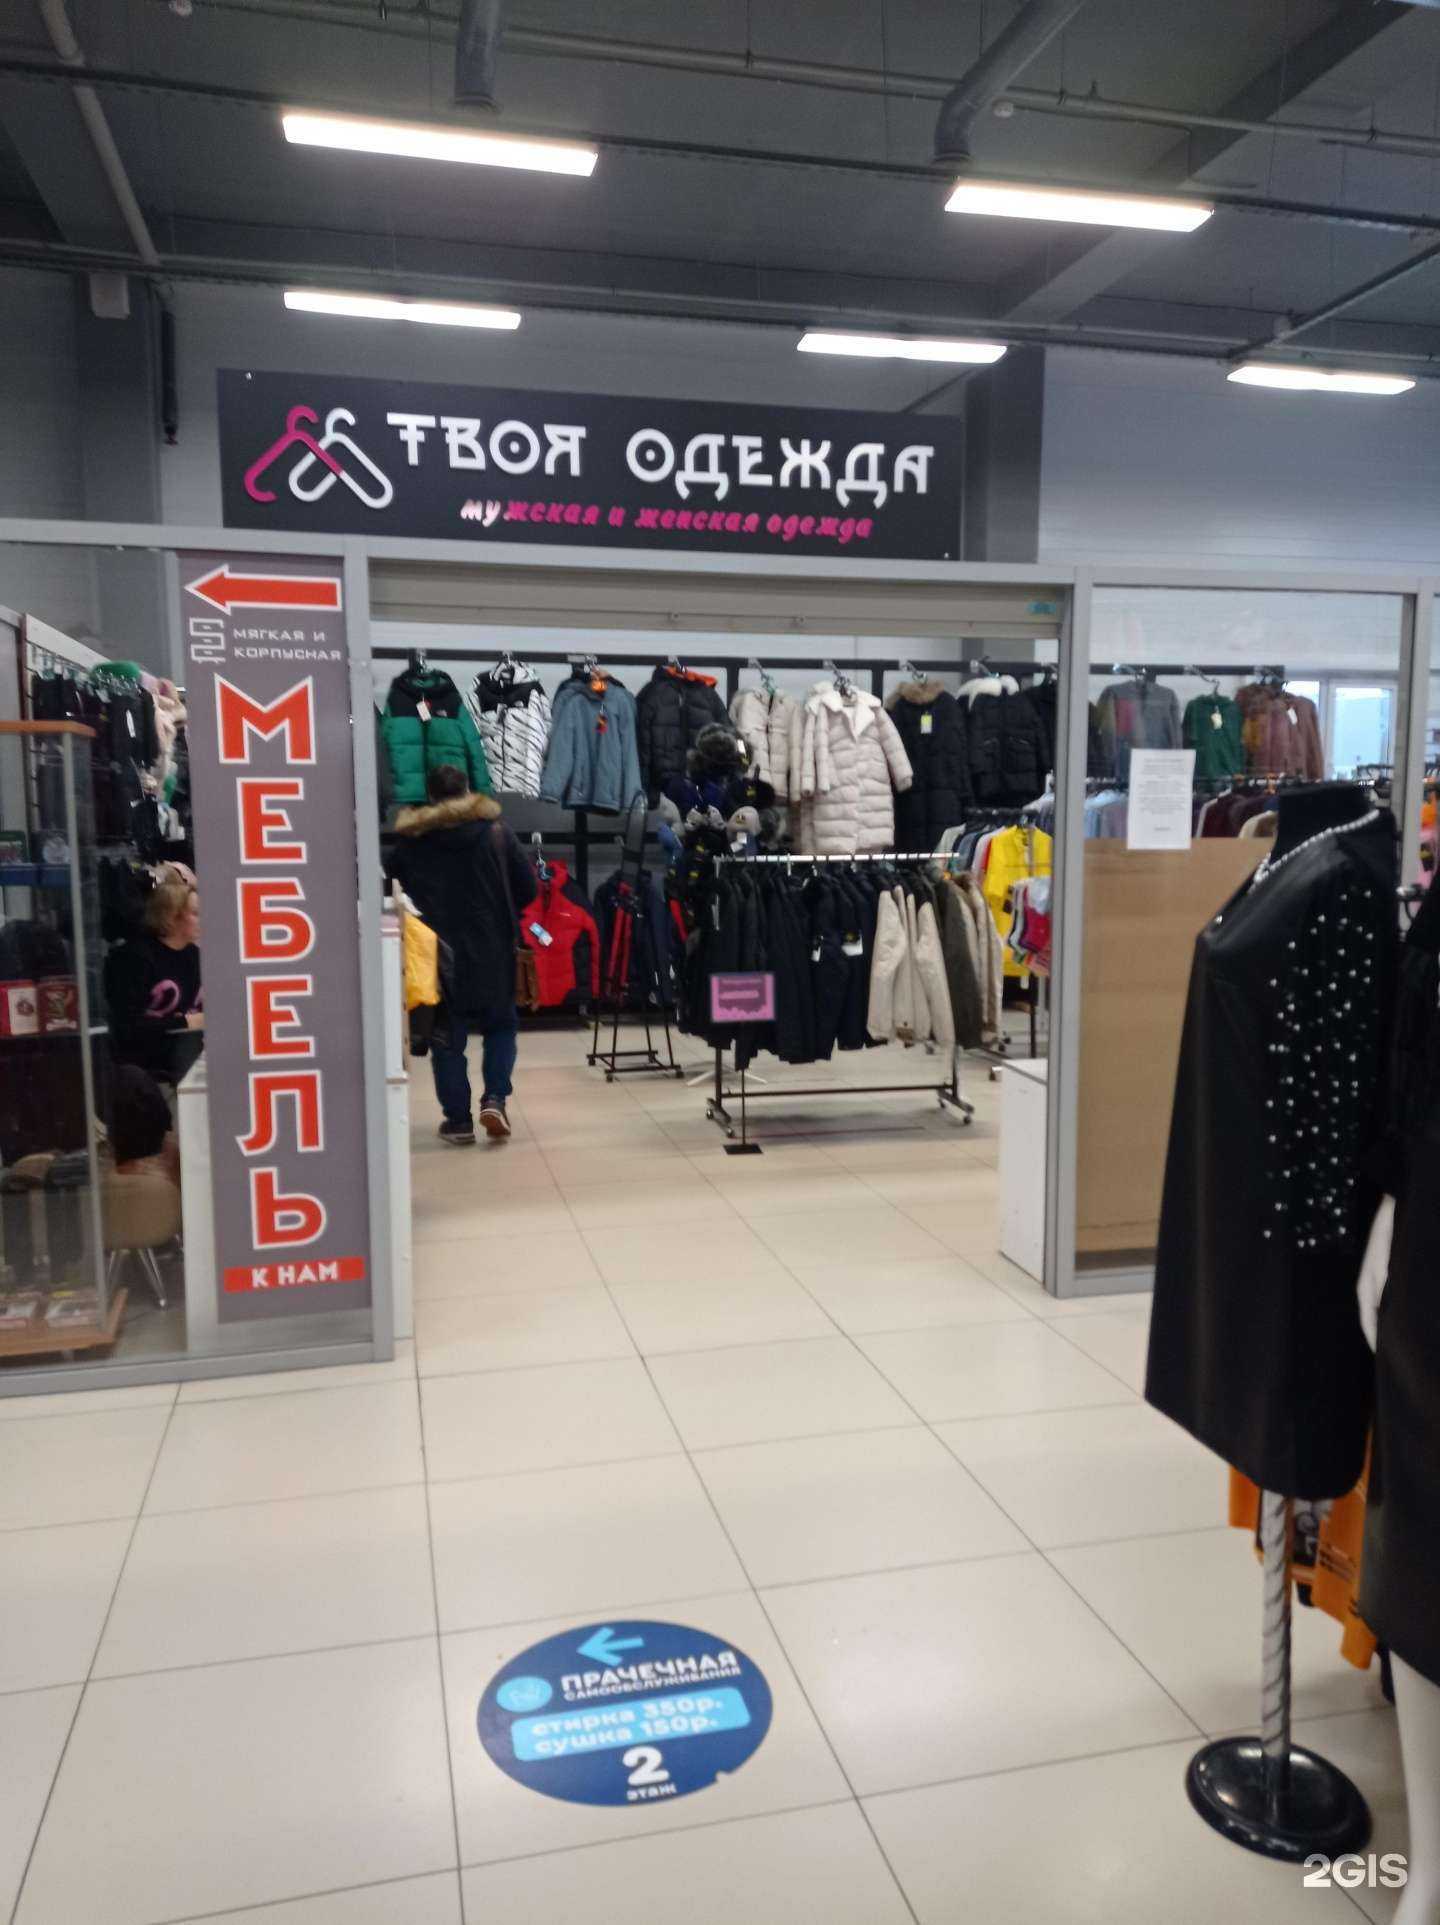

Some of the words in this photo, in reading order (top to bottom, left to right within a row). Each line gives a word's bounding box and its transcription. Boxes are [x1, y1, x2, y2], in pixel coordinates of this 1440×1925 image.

[386, 412, 587, 477] ТВОЯ
[626, 428, 935, 509] ОДЕЖДА
[460, 499, 599, 528] мужская
[608, 506, 626, 528] и
[634, 508, 760, 533] женская
[767, 513, 873, 545] одежда
[233, 628, 305, 642] МЯГКАЯ
[313, 631, 325, 642] И
[234, 646, 342, 661] КОРПУСНАЯ
[214, 672, 328, 1251] МЕБЕЛЬ
[251, 1267, 269, 1288] К
[277, 1260, 339, 1286] НАМ
[561, 1650, 738, 1692] ПРАЧЕЧНАЯ
[531, 1709, 636, 1736] стирка
[534, 1727, 632, 1756] сушка
[622, 1746, 670, 1787] 2
[626, 1782, 677, 1801] этаж
